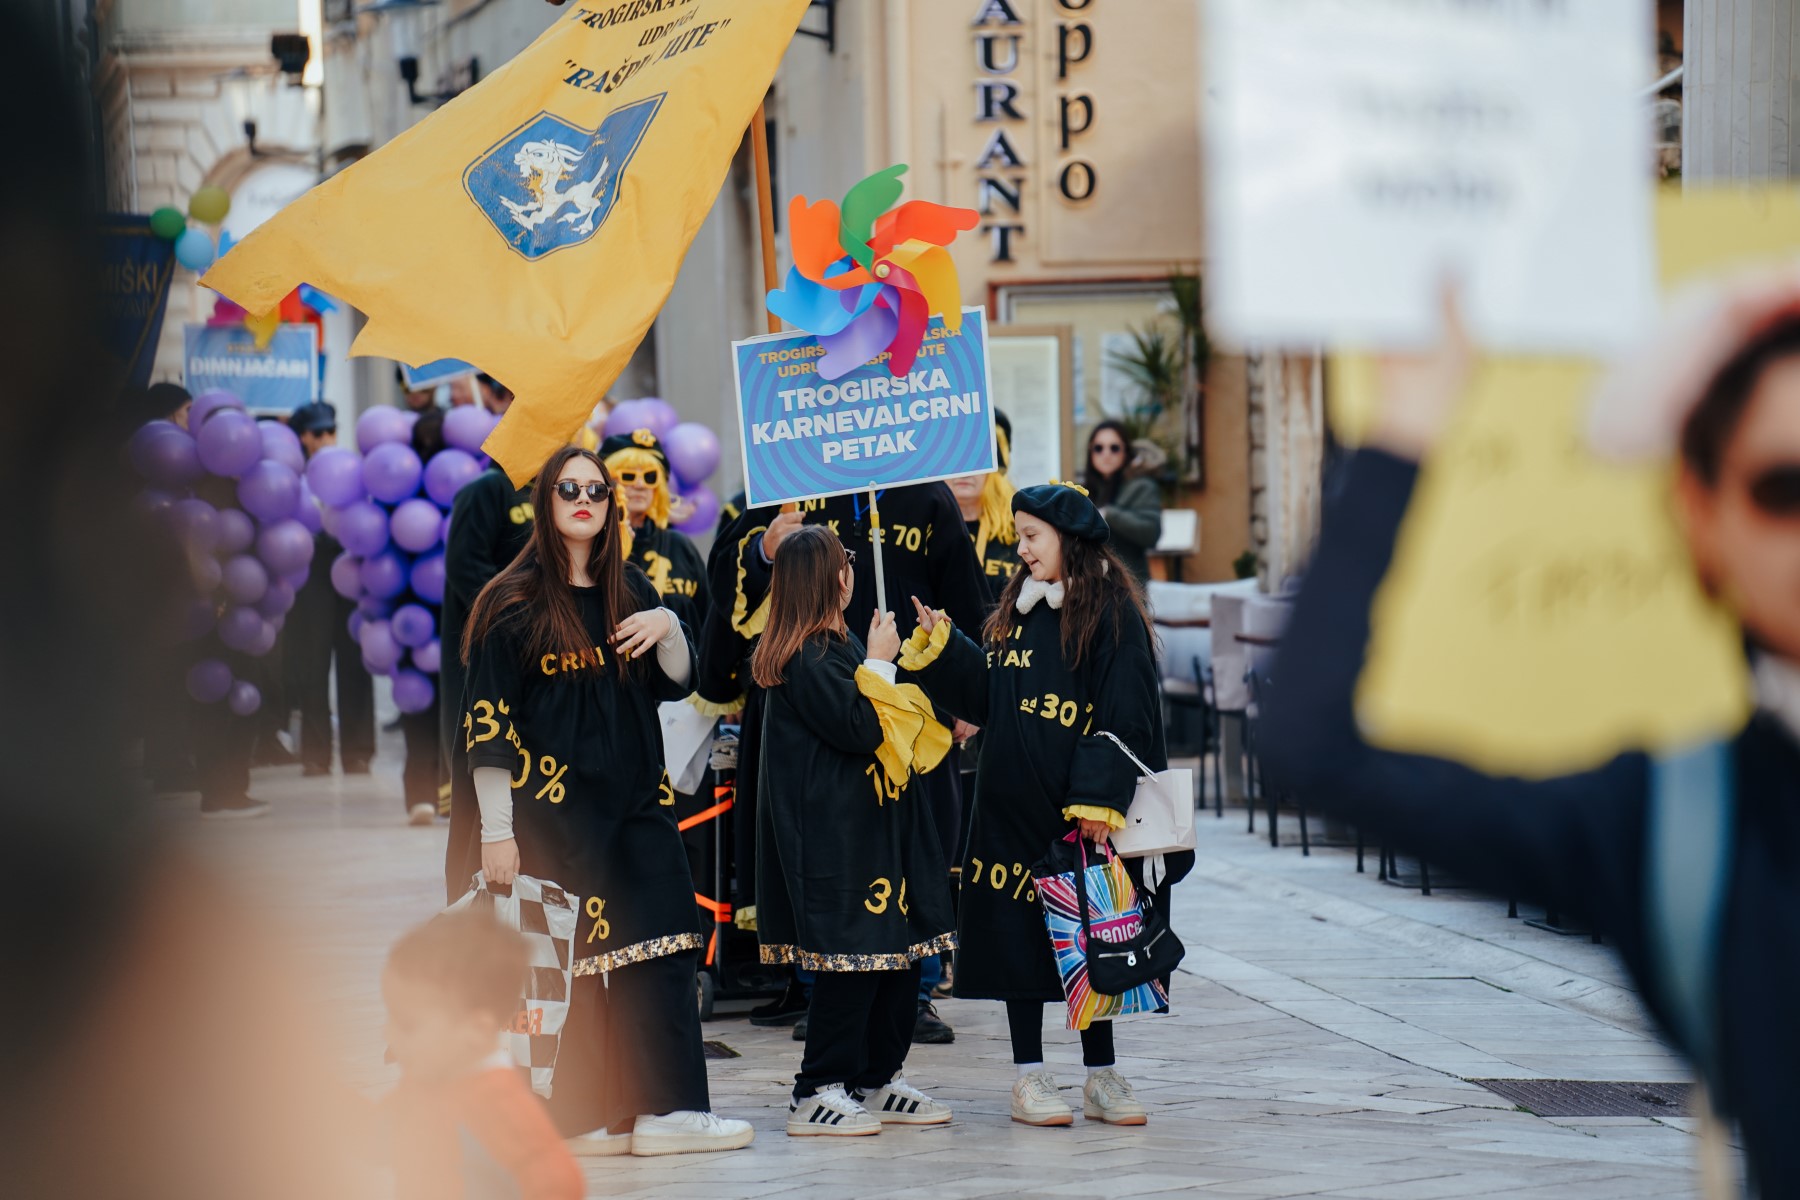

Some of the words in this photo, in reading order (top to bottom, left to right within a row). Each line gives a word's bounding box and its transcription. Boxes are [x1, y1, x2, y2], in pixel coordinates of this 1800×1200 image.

[1055, 0, 1096, 201] ppo
[758, 345, 828, 365] TROGIRS
[778, 368, 951, 411] TROGIRSKA
[752, 392, 981, 444] KARNEVALCRNI
[822, 430, 918, 463] PETAK
